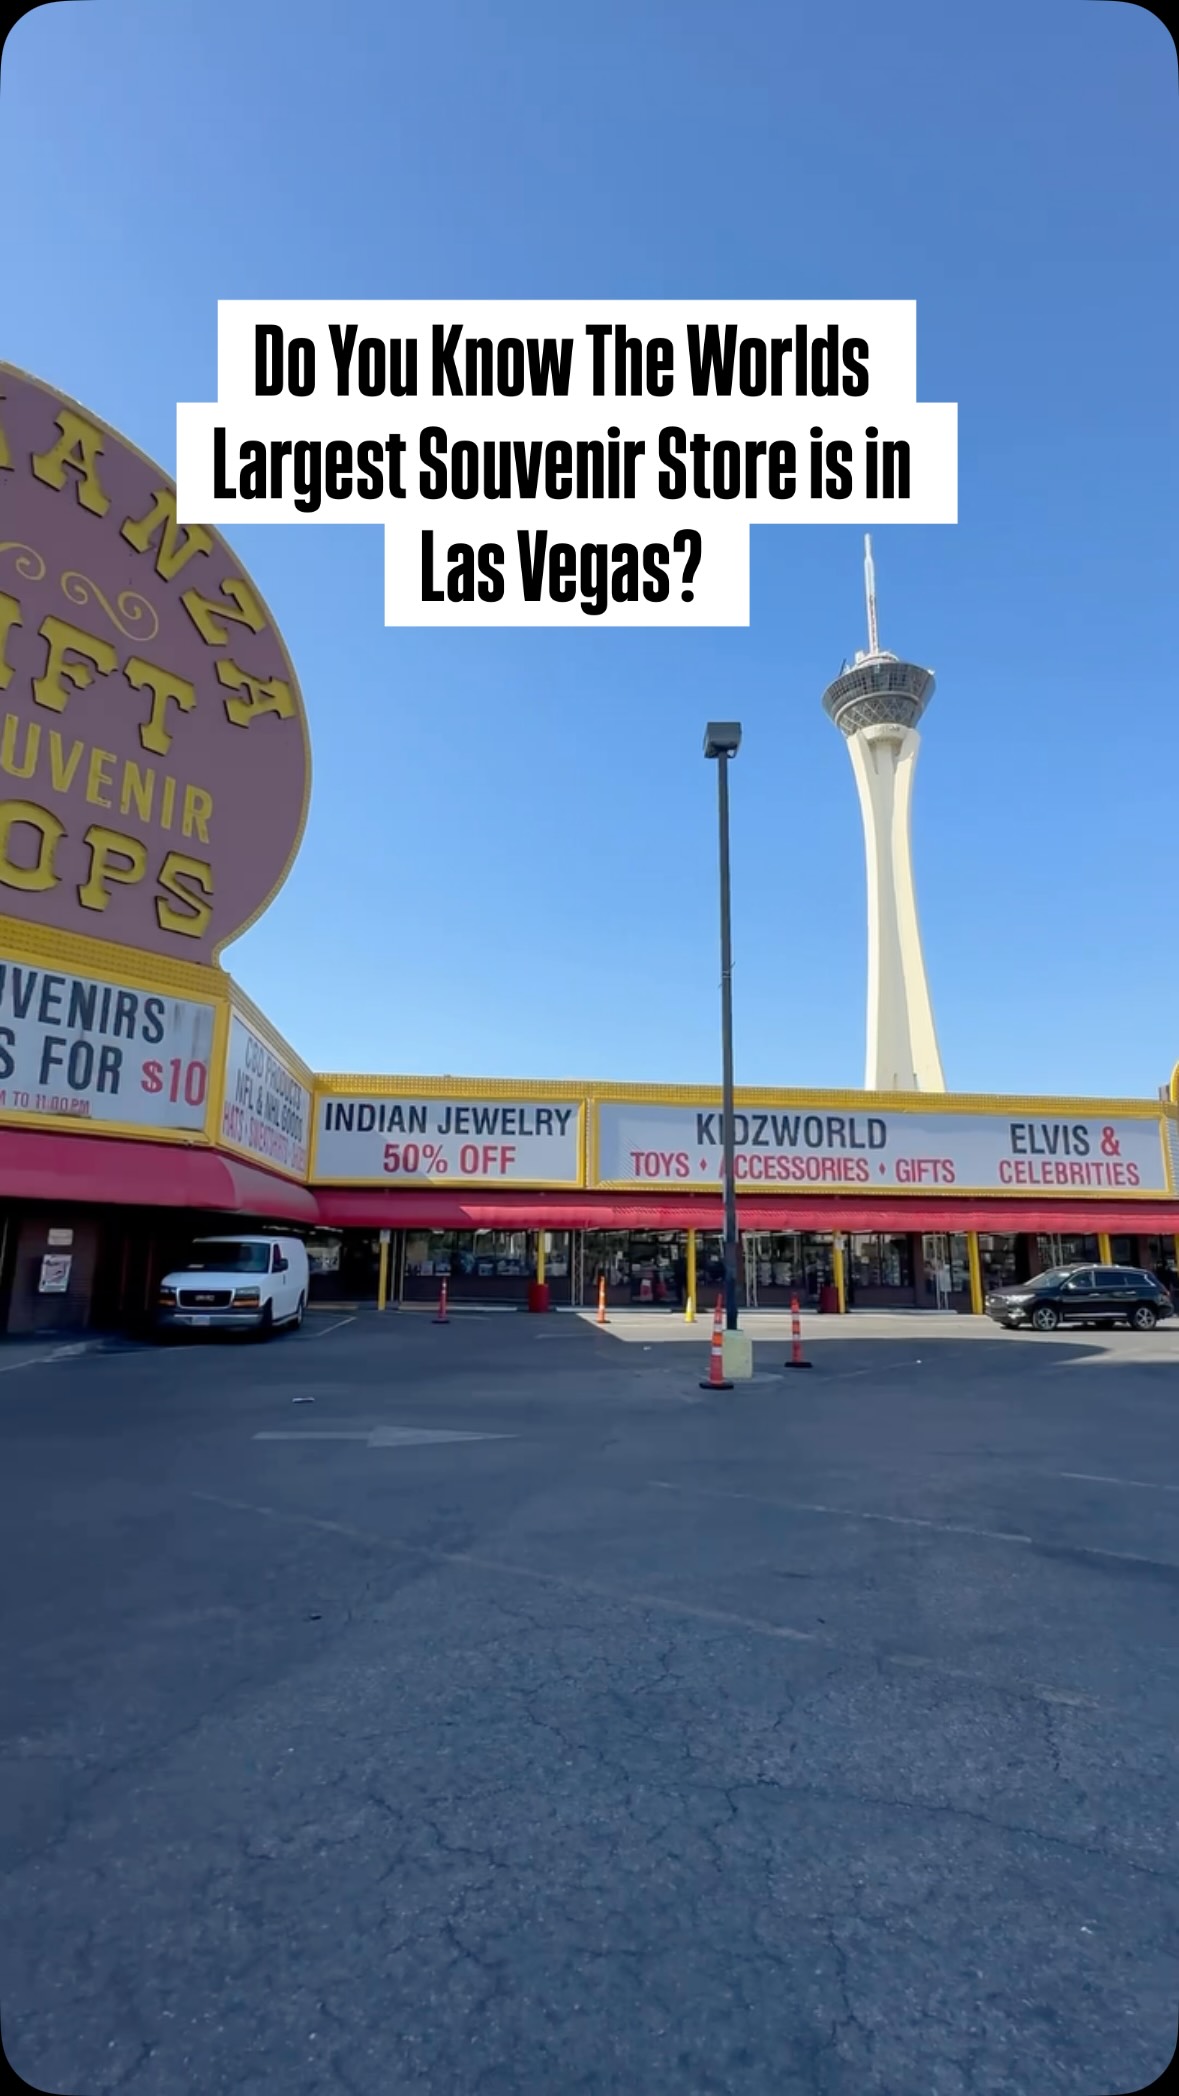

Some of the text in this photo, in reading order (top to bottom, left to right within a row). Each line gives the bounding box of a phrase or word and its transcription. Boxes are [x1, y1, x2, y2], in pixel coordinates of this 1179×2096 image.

[0, 388, 298, 728] ANZA
[1, 713, 213, 844] UVENIR
[0, 799, 214, 938] OPS
[0, 964, 165, 1044] VENIRS
[39, 1035, 123, 1094] FOR
[141, 1058, 207, 1106] $10
[13, 1091, 29, 1108] TO
[325, 1103, 572, 1136] INDIAN JEWELRY
[1010, 1123, 1121, 1156] ELVIS &
[383, 1143, 516, 1174] 50% OFF
[630, 1152, 690, 1178] TOYS
[895, 1159, 955, 1183] GIFTS
[999, 1160, 1140, 1186] CELEBRITIES
